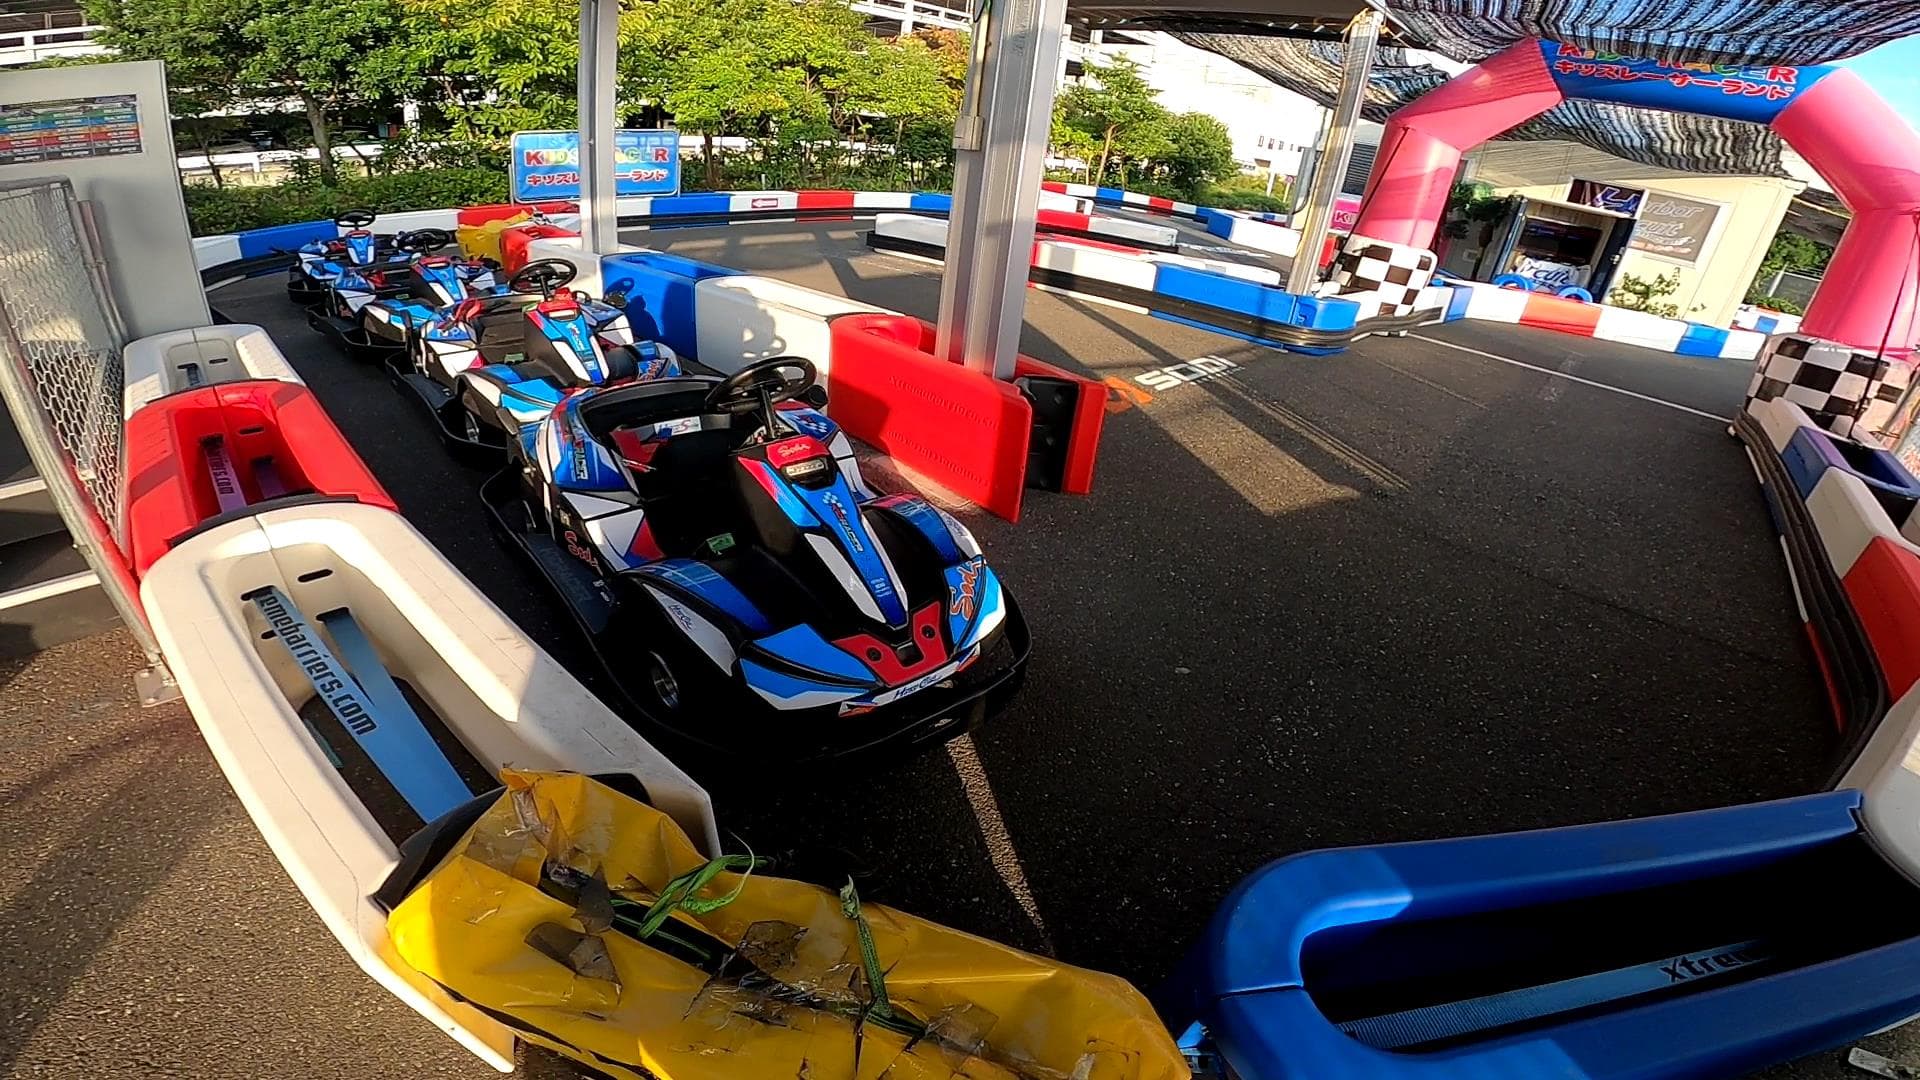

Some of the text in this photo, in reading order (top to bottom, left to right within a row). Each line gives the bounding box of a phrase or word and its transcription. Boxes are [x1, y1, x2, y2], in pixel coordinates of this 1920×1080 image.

[1554, 60, 1796, 101] キッズレーサーランド
